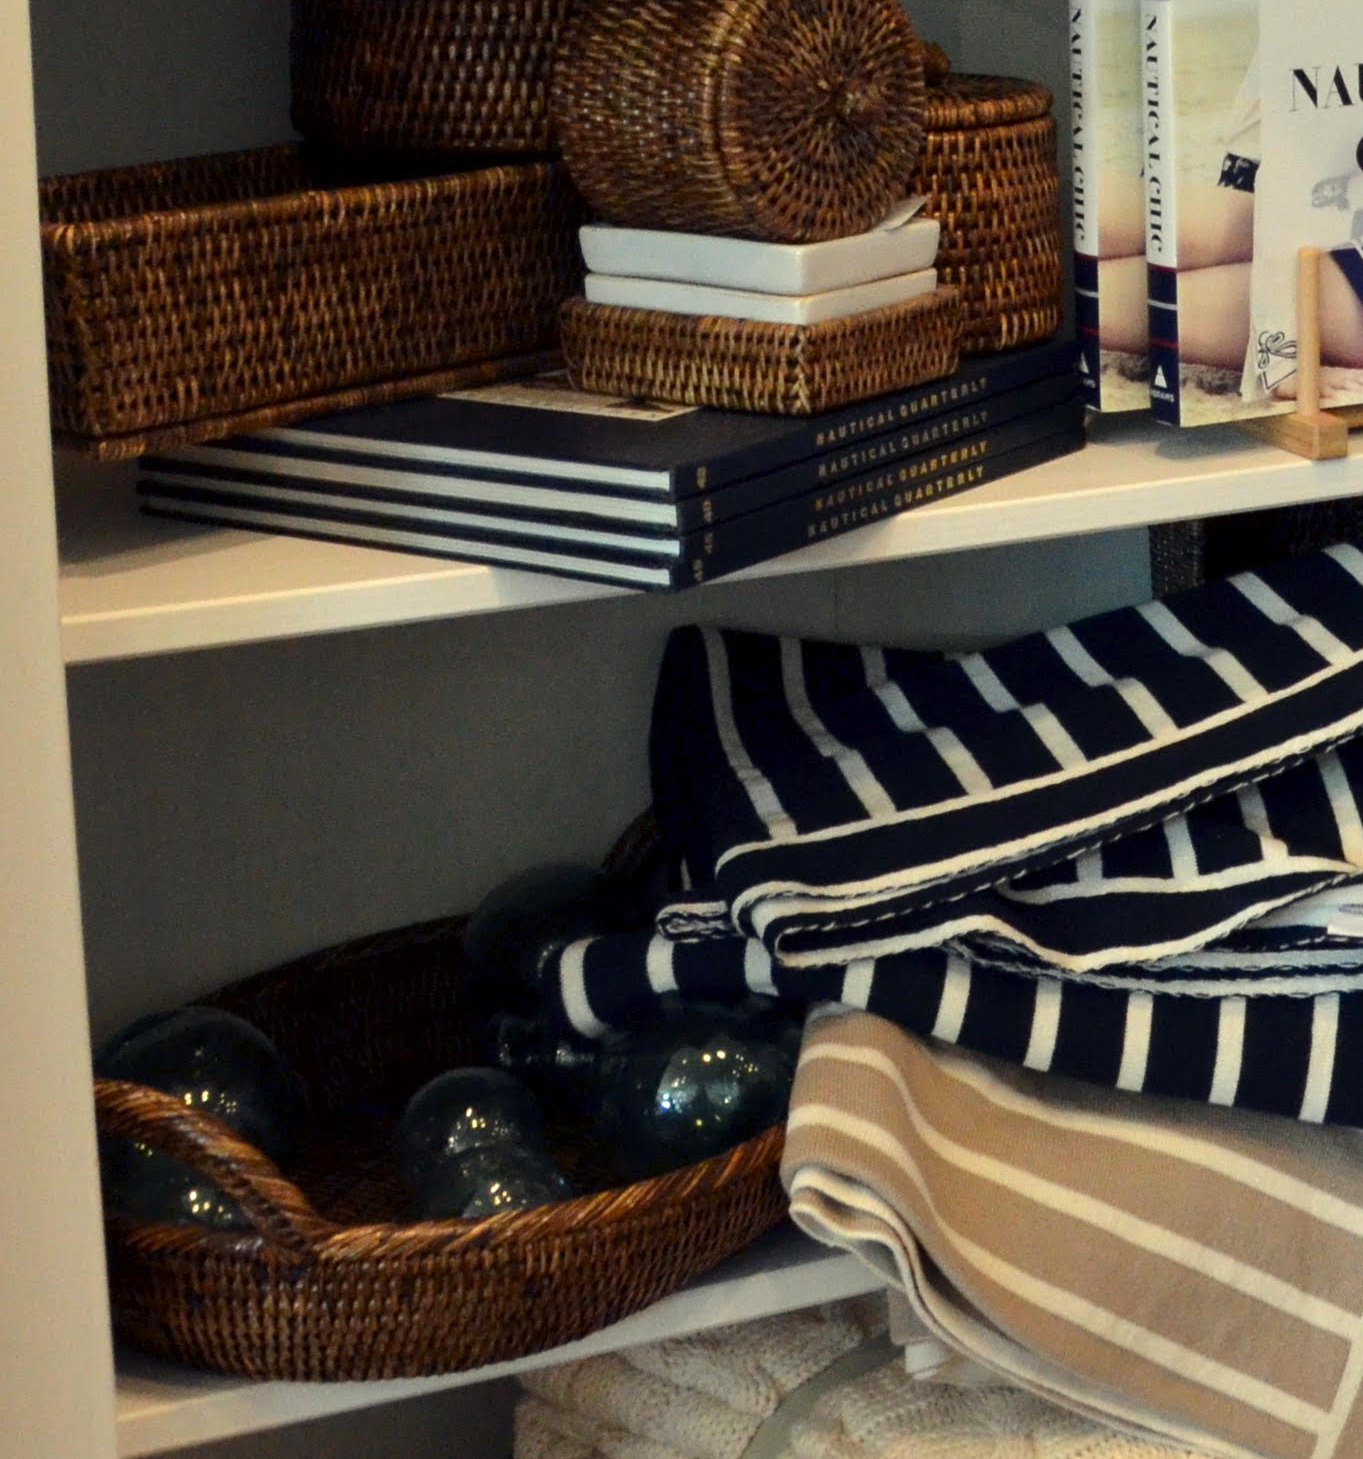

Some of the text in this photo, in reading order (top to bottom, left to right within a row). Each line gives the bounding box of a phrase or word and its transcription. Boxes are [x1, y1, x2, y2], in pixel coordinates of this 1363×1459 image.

[1070, 8, 1086, 241] NAUTICAL CHIC
[1145, 14, 1163, 253] NAUTICAL CHIC
[815, 377, 987, 447] NAUTICAL QUARTERLY
[817, 410, 988, 477] NAUTICAL QUARTERLY
[807, 465, 985, 538] NAUTICAL QUARTERLY
[814, 440, 988, 511] NAUTICAL QUARTERLY
